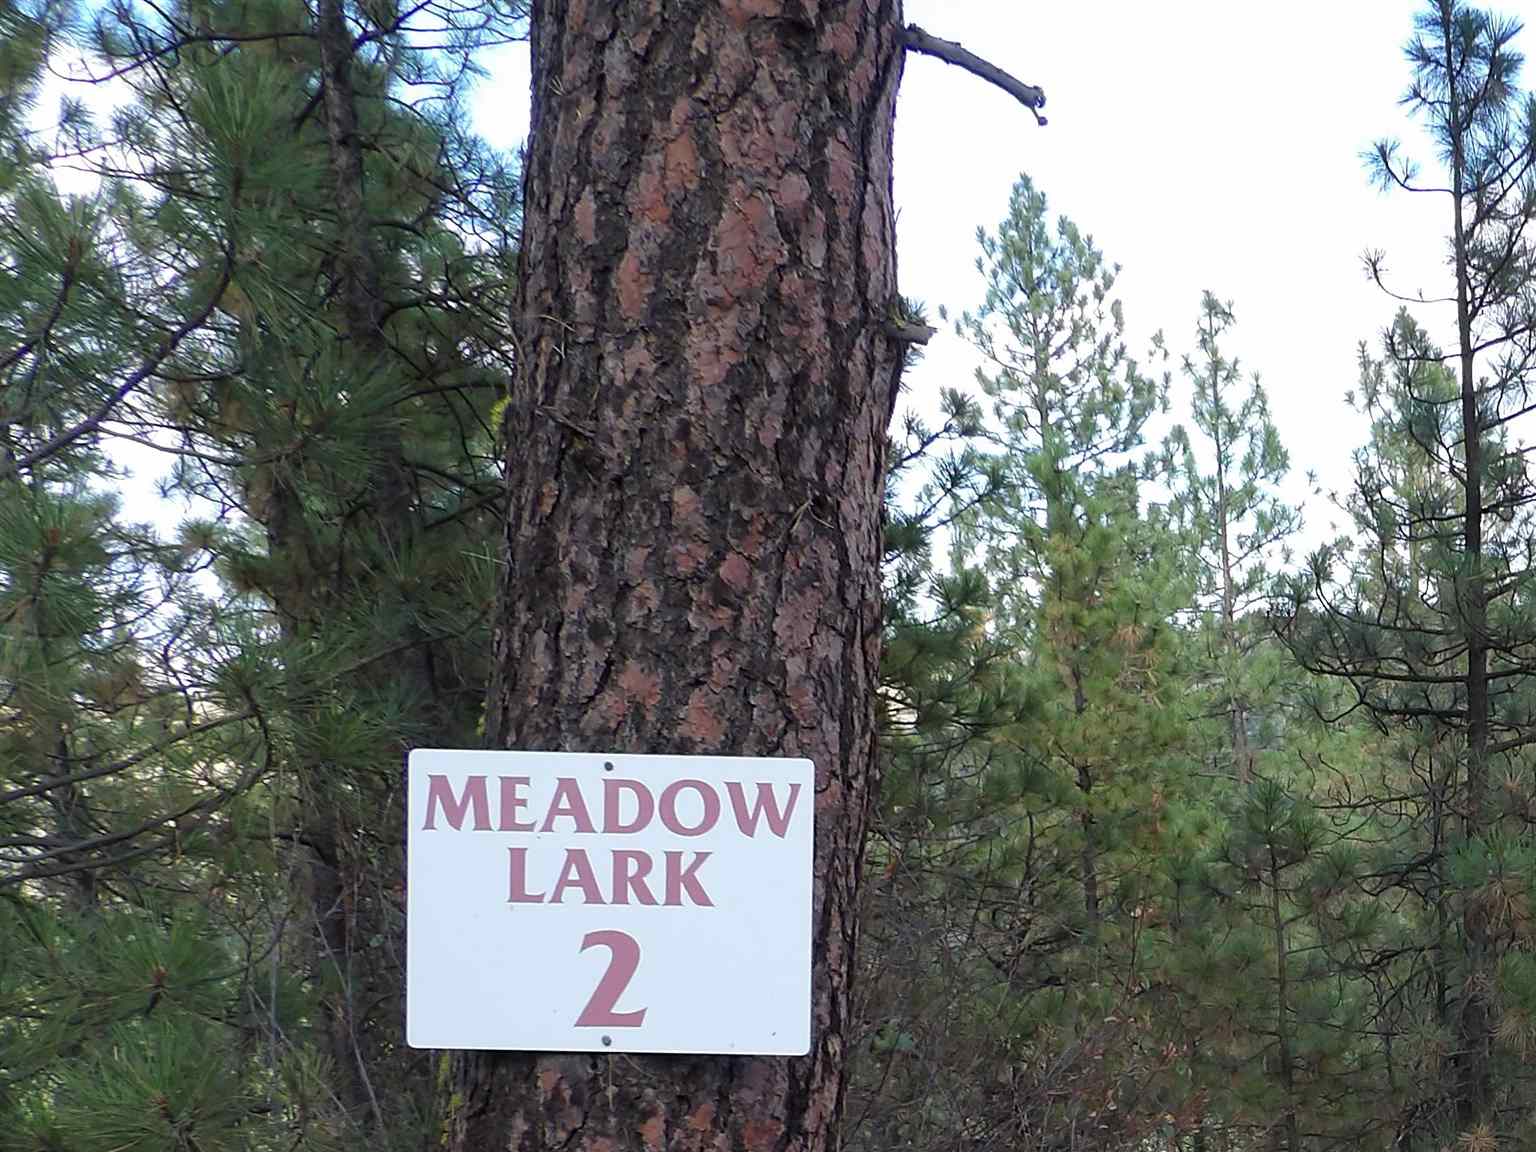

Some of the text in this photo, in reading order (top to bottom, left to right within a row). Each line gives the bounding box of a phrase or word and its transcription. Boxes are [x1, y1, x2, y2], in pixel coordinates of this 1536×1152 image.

[422, 774, 802, 839] MEADOW
[507, 847, 715, 907] LARK
[574, 930, 648, 1028] 2
